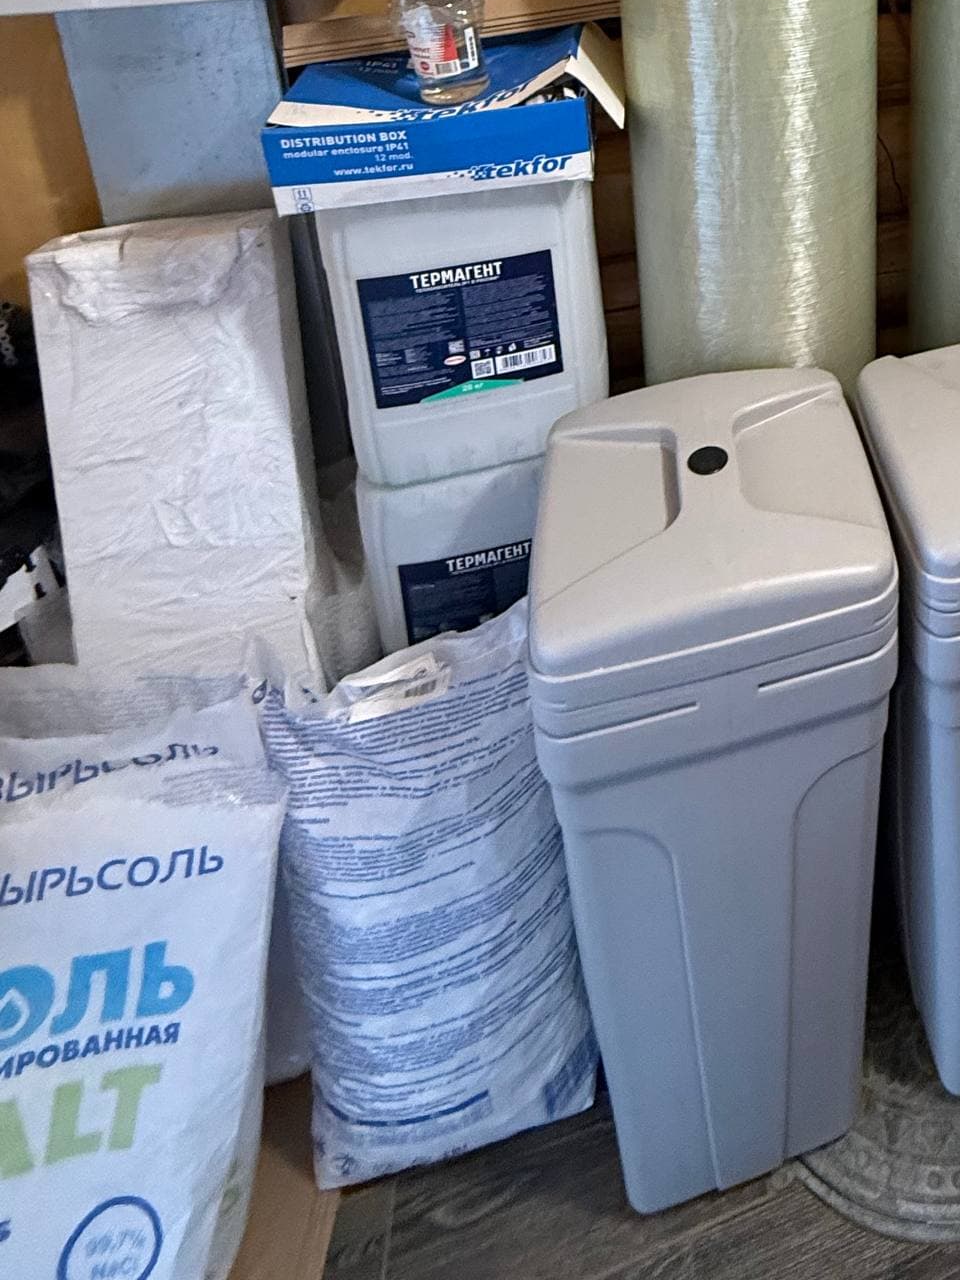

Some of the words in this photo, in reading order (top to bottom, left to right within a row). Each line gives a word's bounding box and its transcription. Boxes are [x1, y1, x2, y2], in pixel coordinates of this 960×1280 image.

[280, 133, 377, 149] DISTRIBUTION
[379, 130, 407, 141] BOX
[283, 148, 329, 159] modular
[331, 145, 384, 156] enclosure
[386, 142, 409, 152] IP41
[375, 153, 386, 162] 12
[388, 152, 414, 161] mod.
[478, 154, 573, 181] tekfor
[333, 162, 414, 176] www.tekfor.ru
[409, 261, 503, 289] ТЕРМАГЕНТ
[446, 542, 531, 572] ТЕРМАГЕНТ
[0, 743, 219, 803] ЫРЬСОЛЬ
